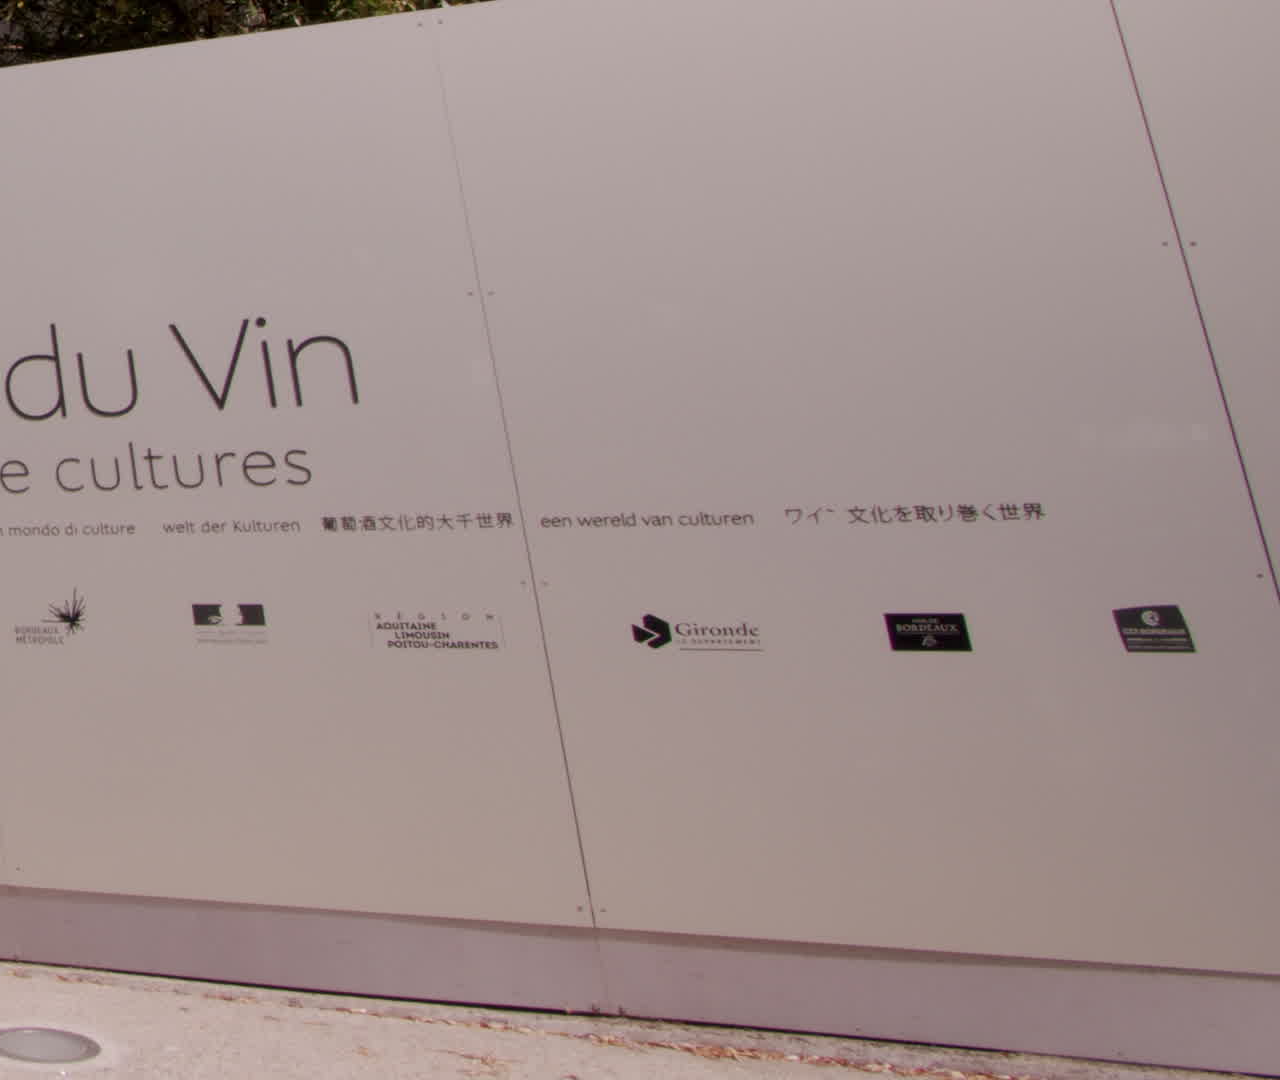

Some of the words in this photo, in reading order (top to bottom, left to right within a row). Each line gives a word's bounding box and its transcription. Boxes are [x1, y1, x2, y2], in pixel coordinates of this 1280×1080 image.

[4, 323, 138, 421] du
[167, 316, 360, 412] Vin
[55, 442, 313, 493] cultures
[7, 522, 61, 537] mondo
[82, 520, 136, 536] culture
[161, 519, 195, 535] welt
[200, 518, 227, 534] der
[540, 515, 573, 529] een
[577, 512, 637, 529] wereld
[641, 515, 674, 528] van
[678, 511, 756, 528] culturen
[674, 622, 760, 637] Gironde
